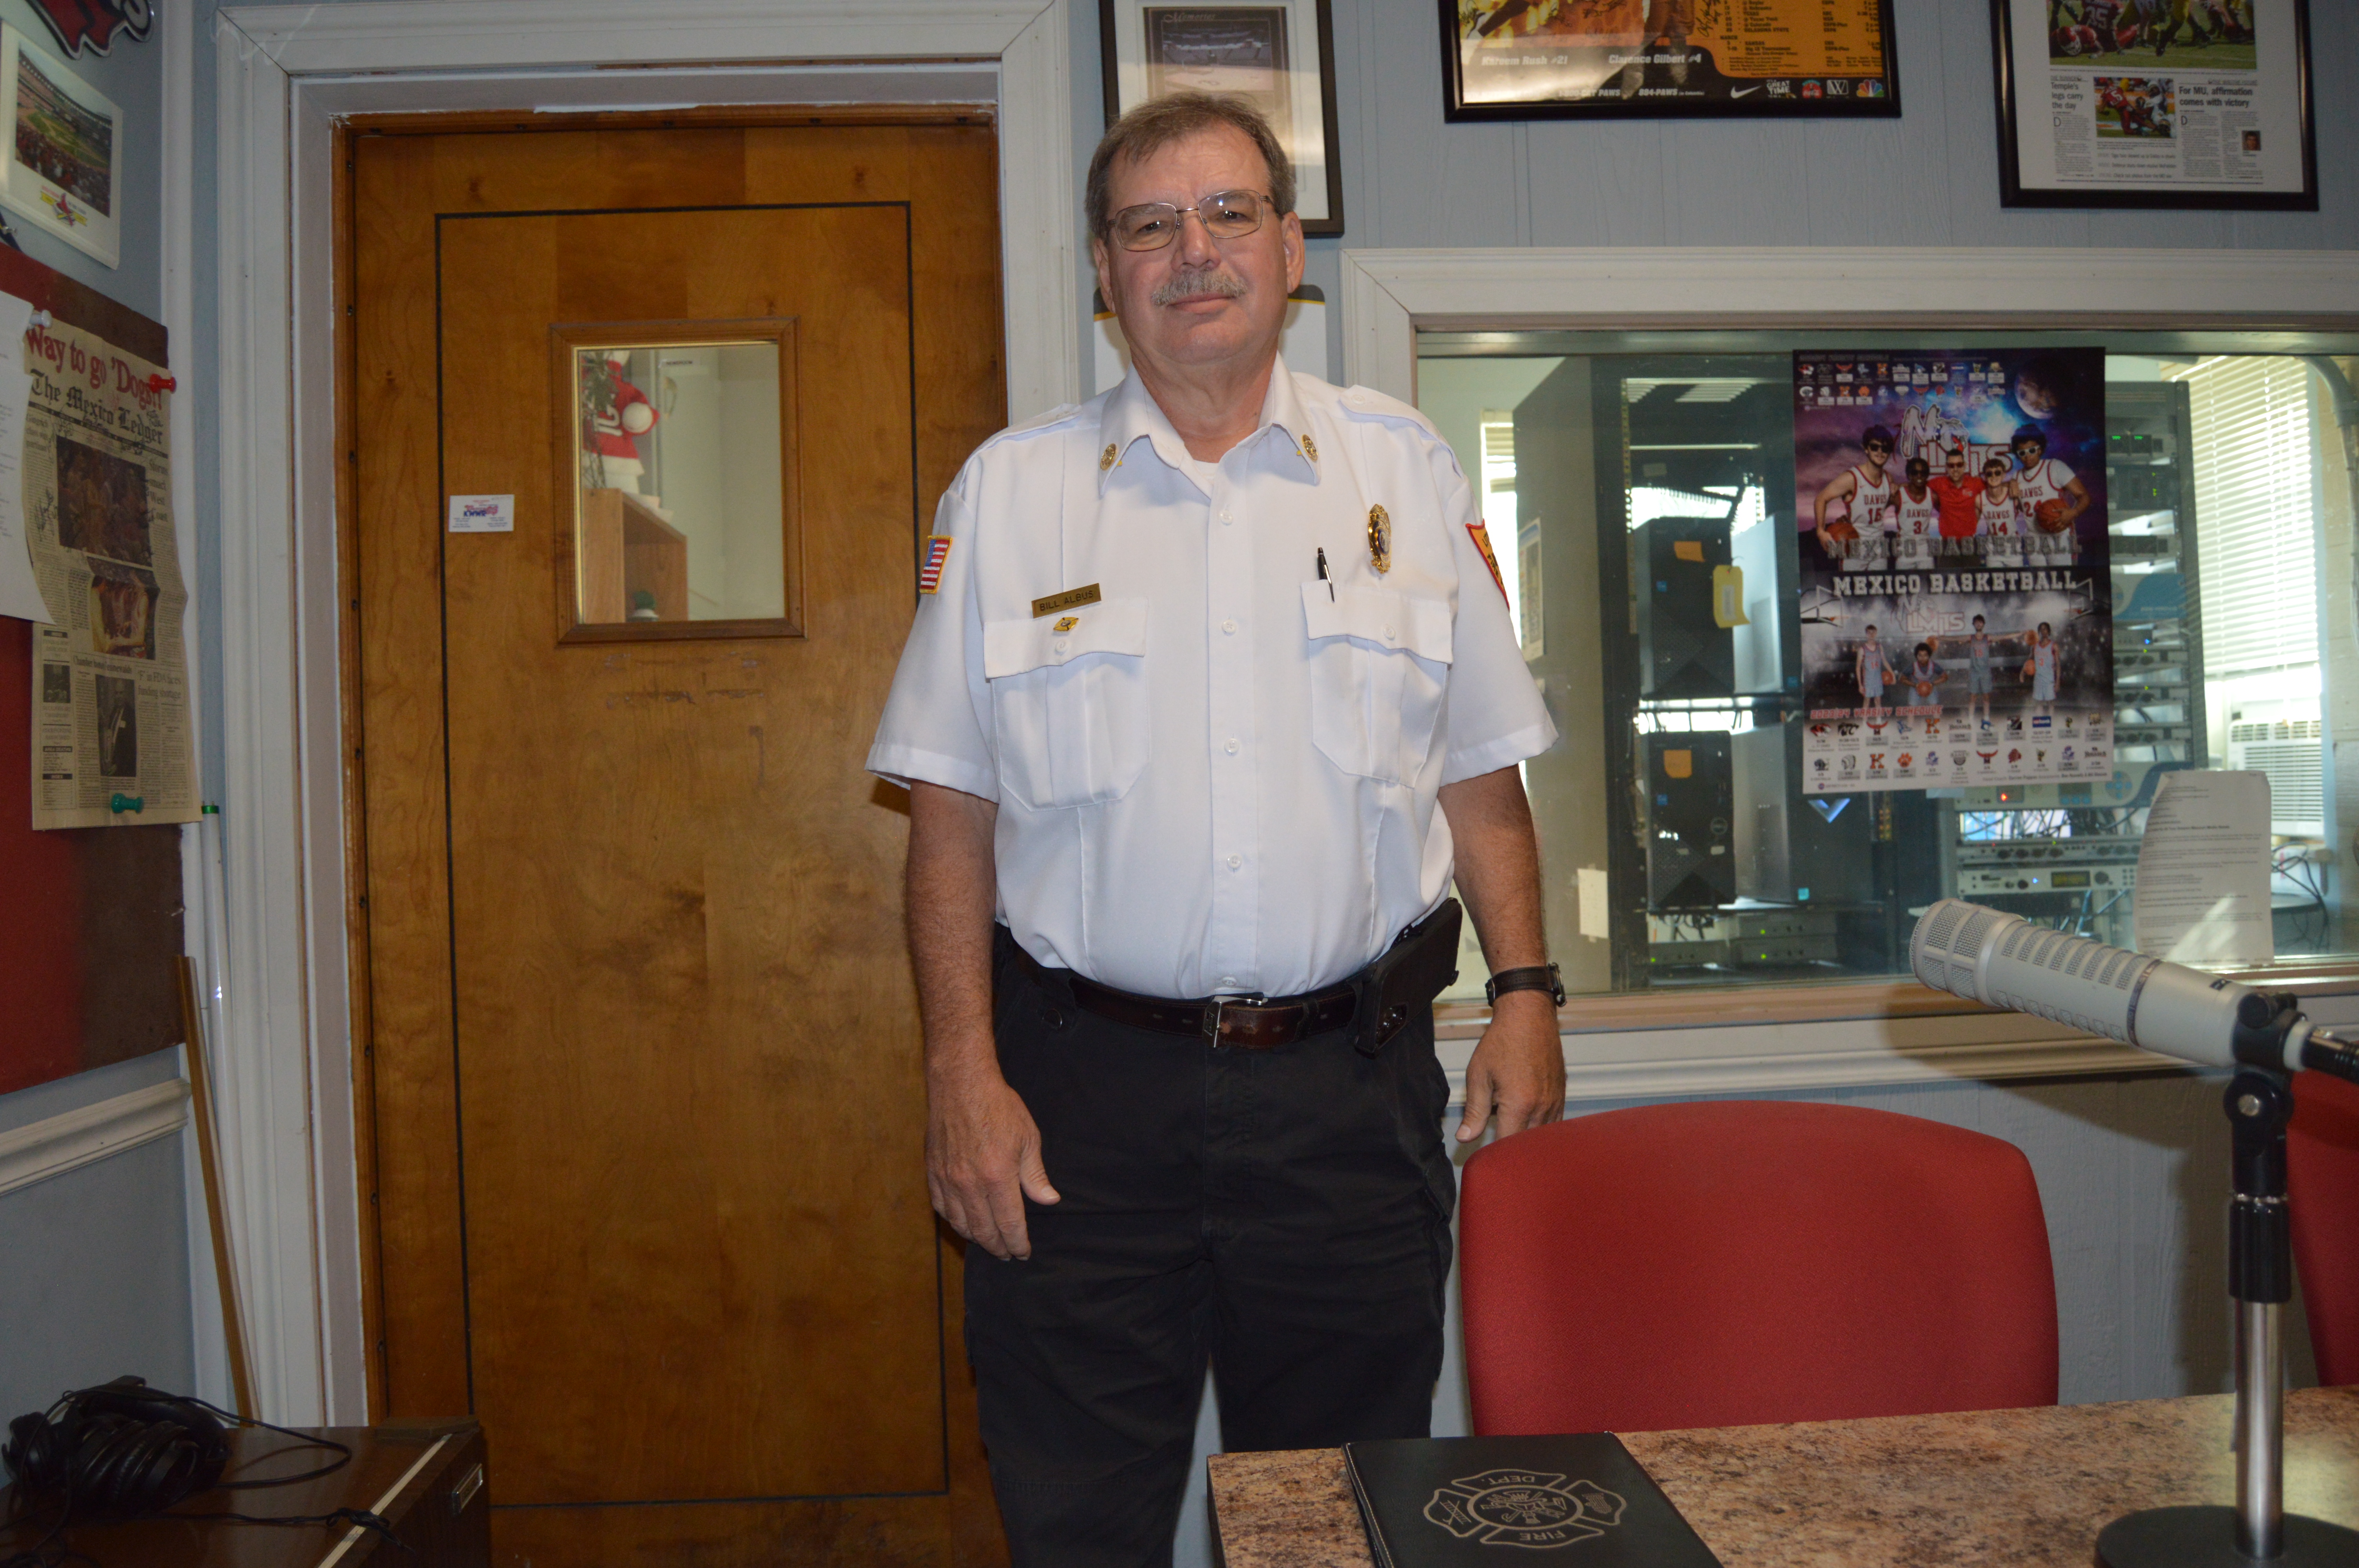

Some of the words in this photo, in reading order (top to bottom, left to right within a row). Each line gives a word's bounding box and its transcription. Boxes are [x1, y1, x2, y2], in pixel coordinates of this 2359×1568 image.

[1481, 56, 1519, 66] Kareem
[1522, 55, 1547, 65] Rush
[1551, 54, 1568, 65] #21
[1608, 54, 1650, 64] Clarence
[1653, 53, 1685, 64] Gilbert
[1688, 53, 1701, 63] #4
[1768, 86, 1790, 95] TIME
[2051, 82, 2079, 91] Temple's
[2179, 86, 2191, 95] For
[2193, 86, 2209, 96] MU,
[2211, 86, 2254, 96] affirmation
[2052, 92, 2065, 101] legs
[2066, 93, 2083, 101] carry
[2064, 102, 2076, 111] day
[2224, 98, 2250, 108] victory
[25, 325, 66, 374] Way
[69, 338, 86, 375] to
[90, 356, 107, 390] go
[30, 368, 61, 405] The
[66, 385, 114, 425] Mexico
[118, 406, 164, 445] Ledger
[1864, 494, 1886, 505] DAWGS
[1906, 509, 1929, 518] DAWGS
[1987, 510, 2010, 519] DAWGS
[1913, 521, 1922, 535] 3
[1992, 521, 2008, 535] 14
[1827, 537, 1919, 559] MEXICO
[1926, 535, 2082, 557] BASKETBALL
[1833, 574, 1921, 596] MEXICO
[1929, 571, 2077, 593] BASKETBALL
[1040, 600, 1061, 612] BILL
[1063, 590, 1094, 604] ALBUS
[1854, 707, 1892, 717] VARSITY
[1895, 705, 1943, 716] SCHEDULE
[1481, 1475, 1535, 1485] DEPT.
[1519, 1530, 1566, 1541] FIRE
